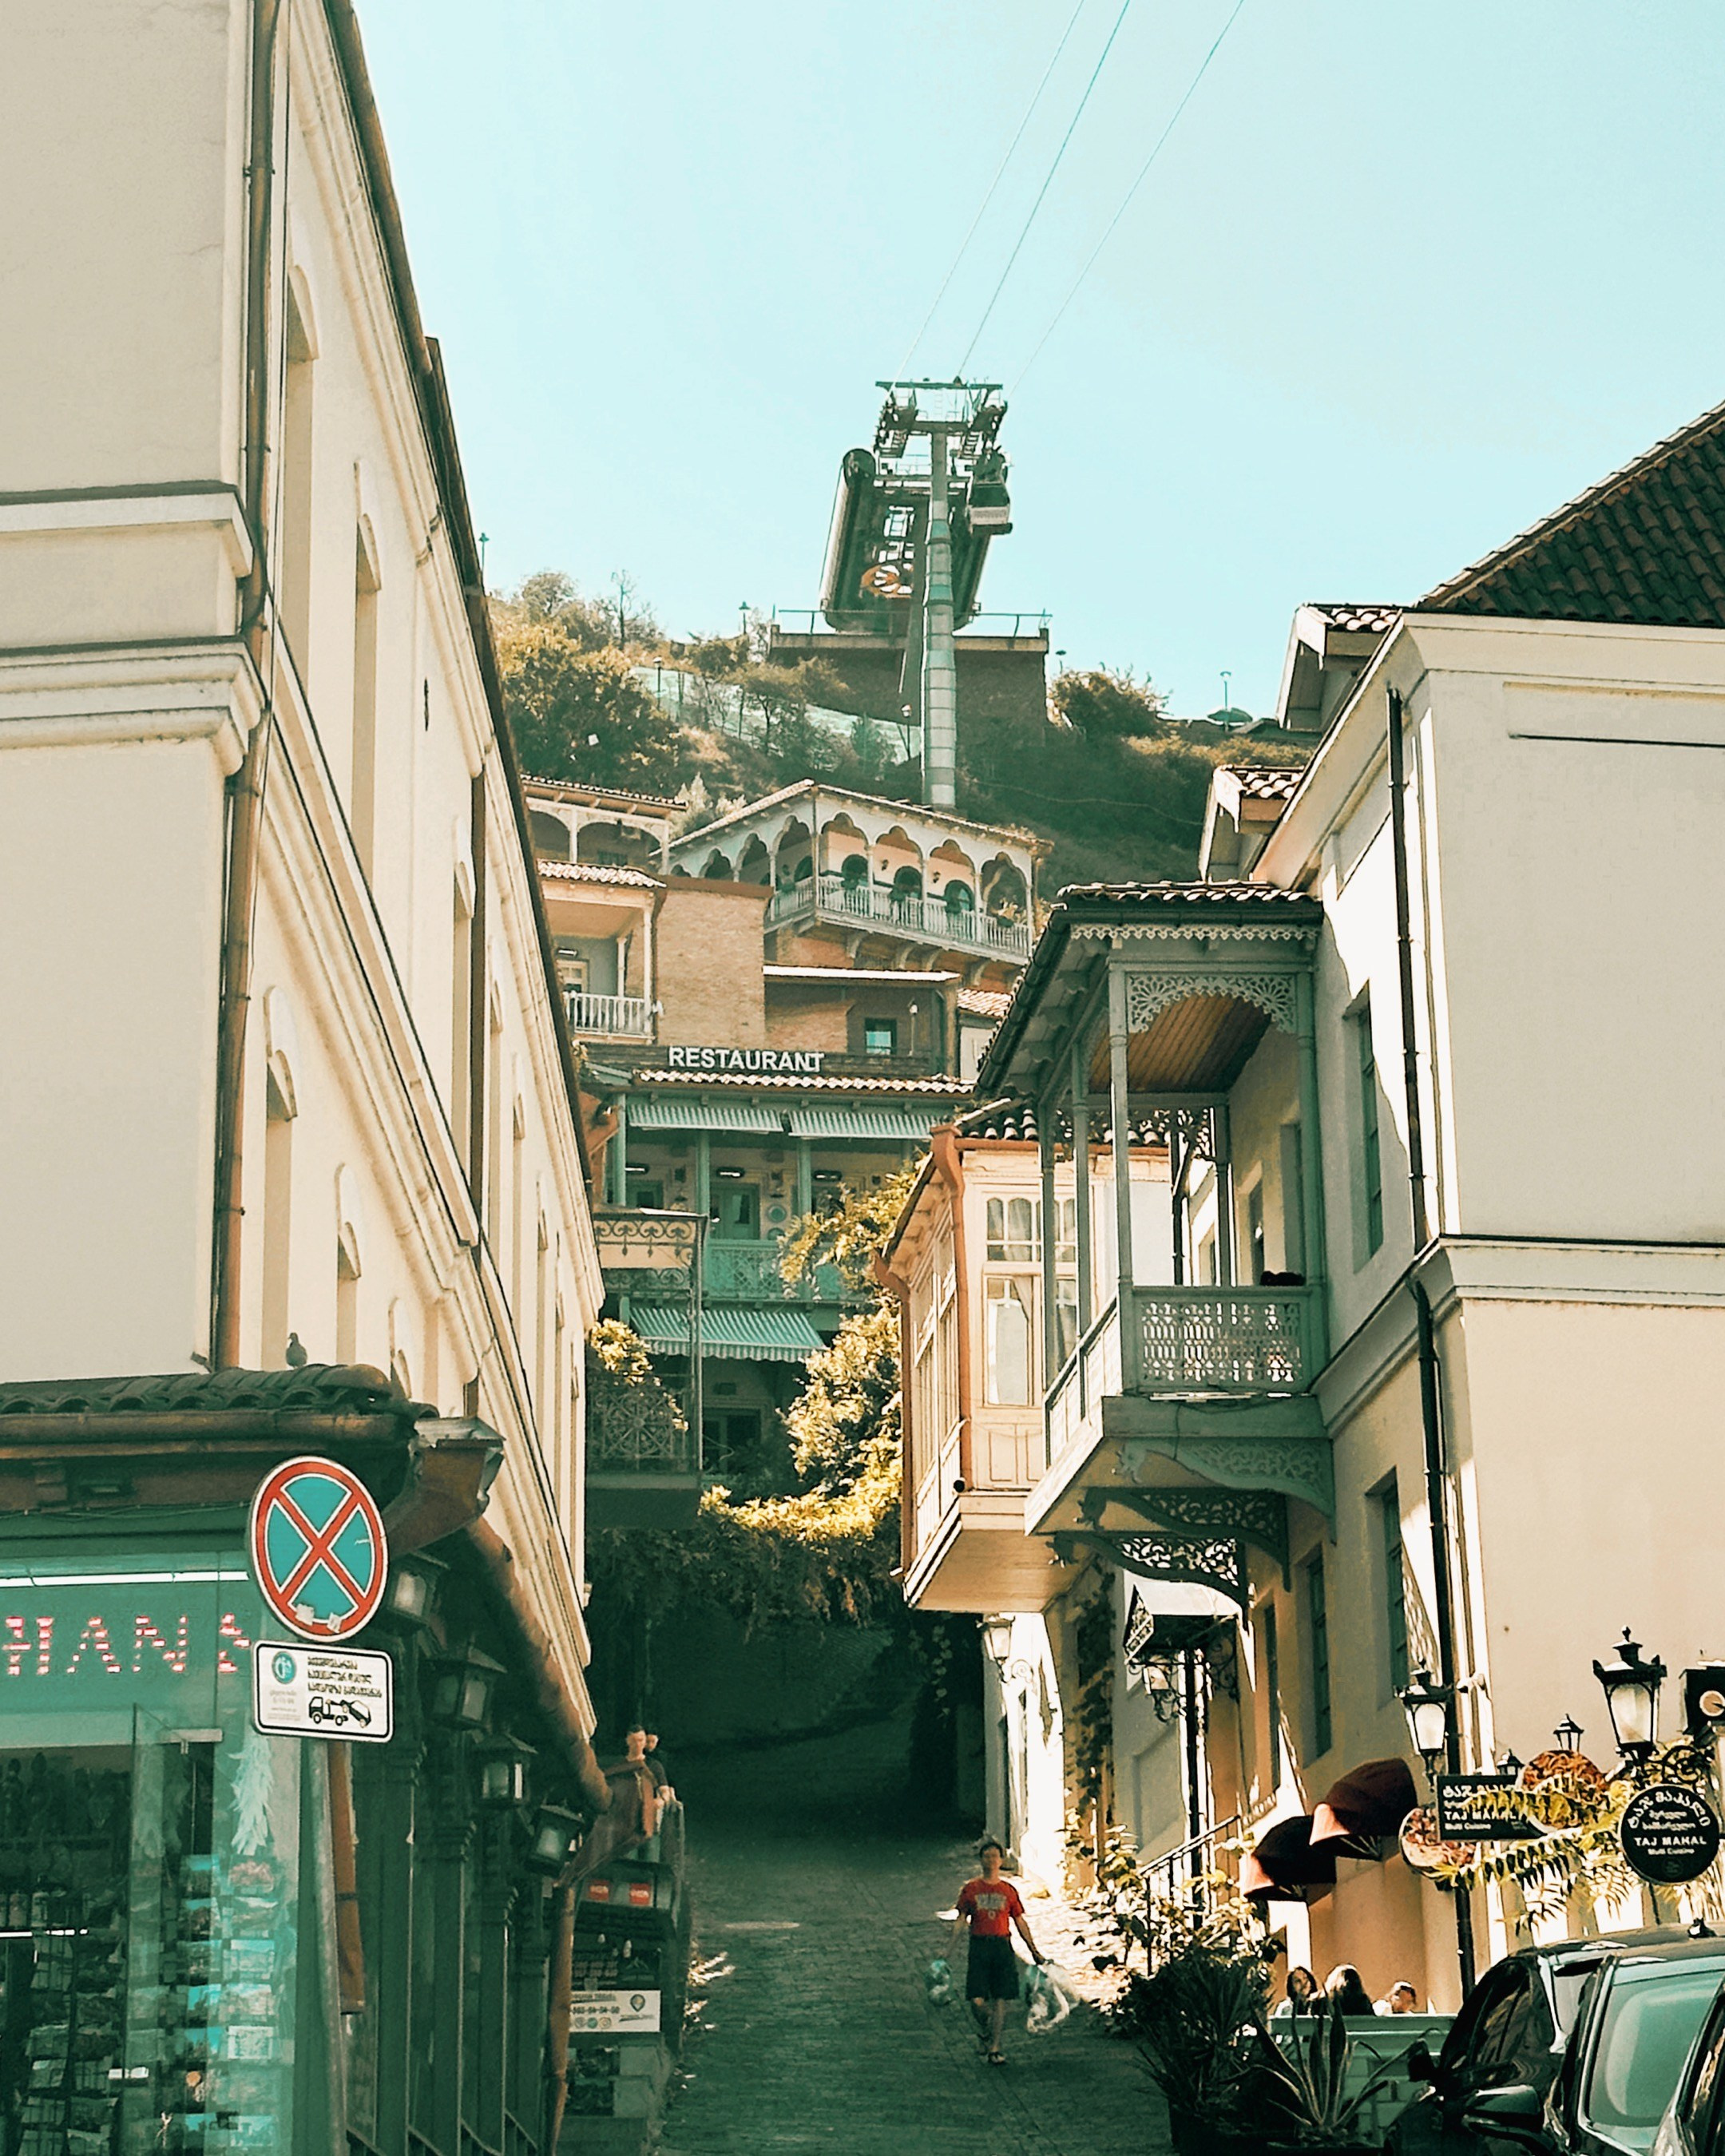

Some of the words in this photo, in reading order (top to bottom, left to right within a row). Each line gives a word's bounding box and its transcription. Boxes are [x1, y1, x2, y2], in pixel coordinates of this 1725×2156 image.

[668, 1044, 825, 1073] RESTAURANT
[1444, 1810, 1467, 1821] TAJ
[1634, 1837, 1657, 1846] TAJ
[1662, 1836, 1707, 1846] MAHAL
